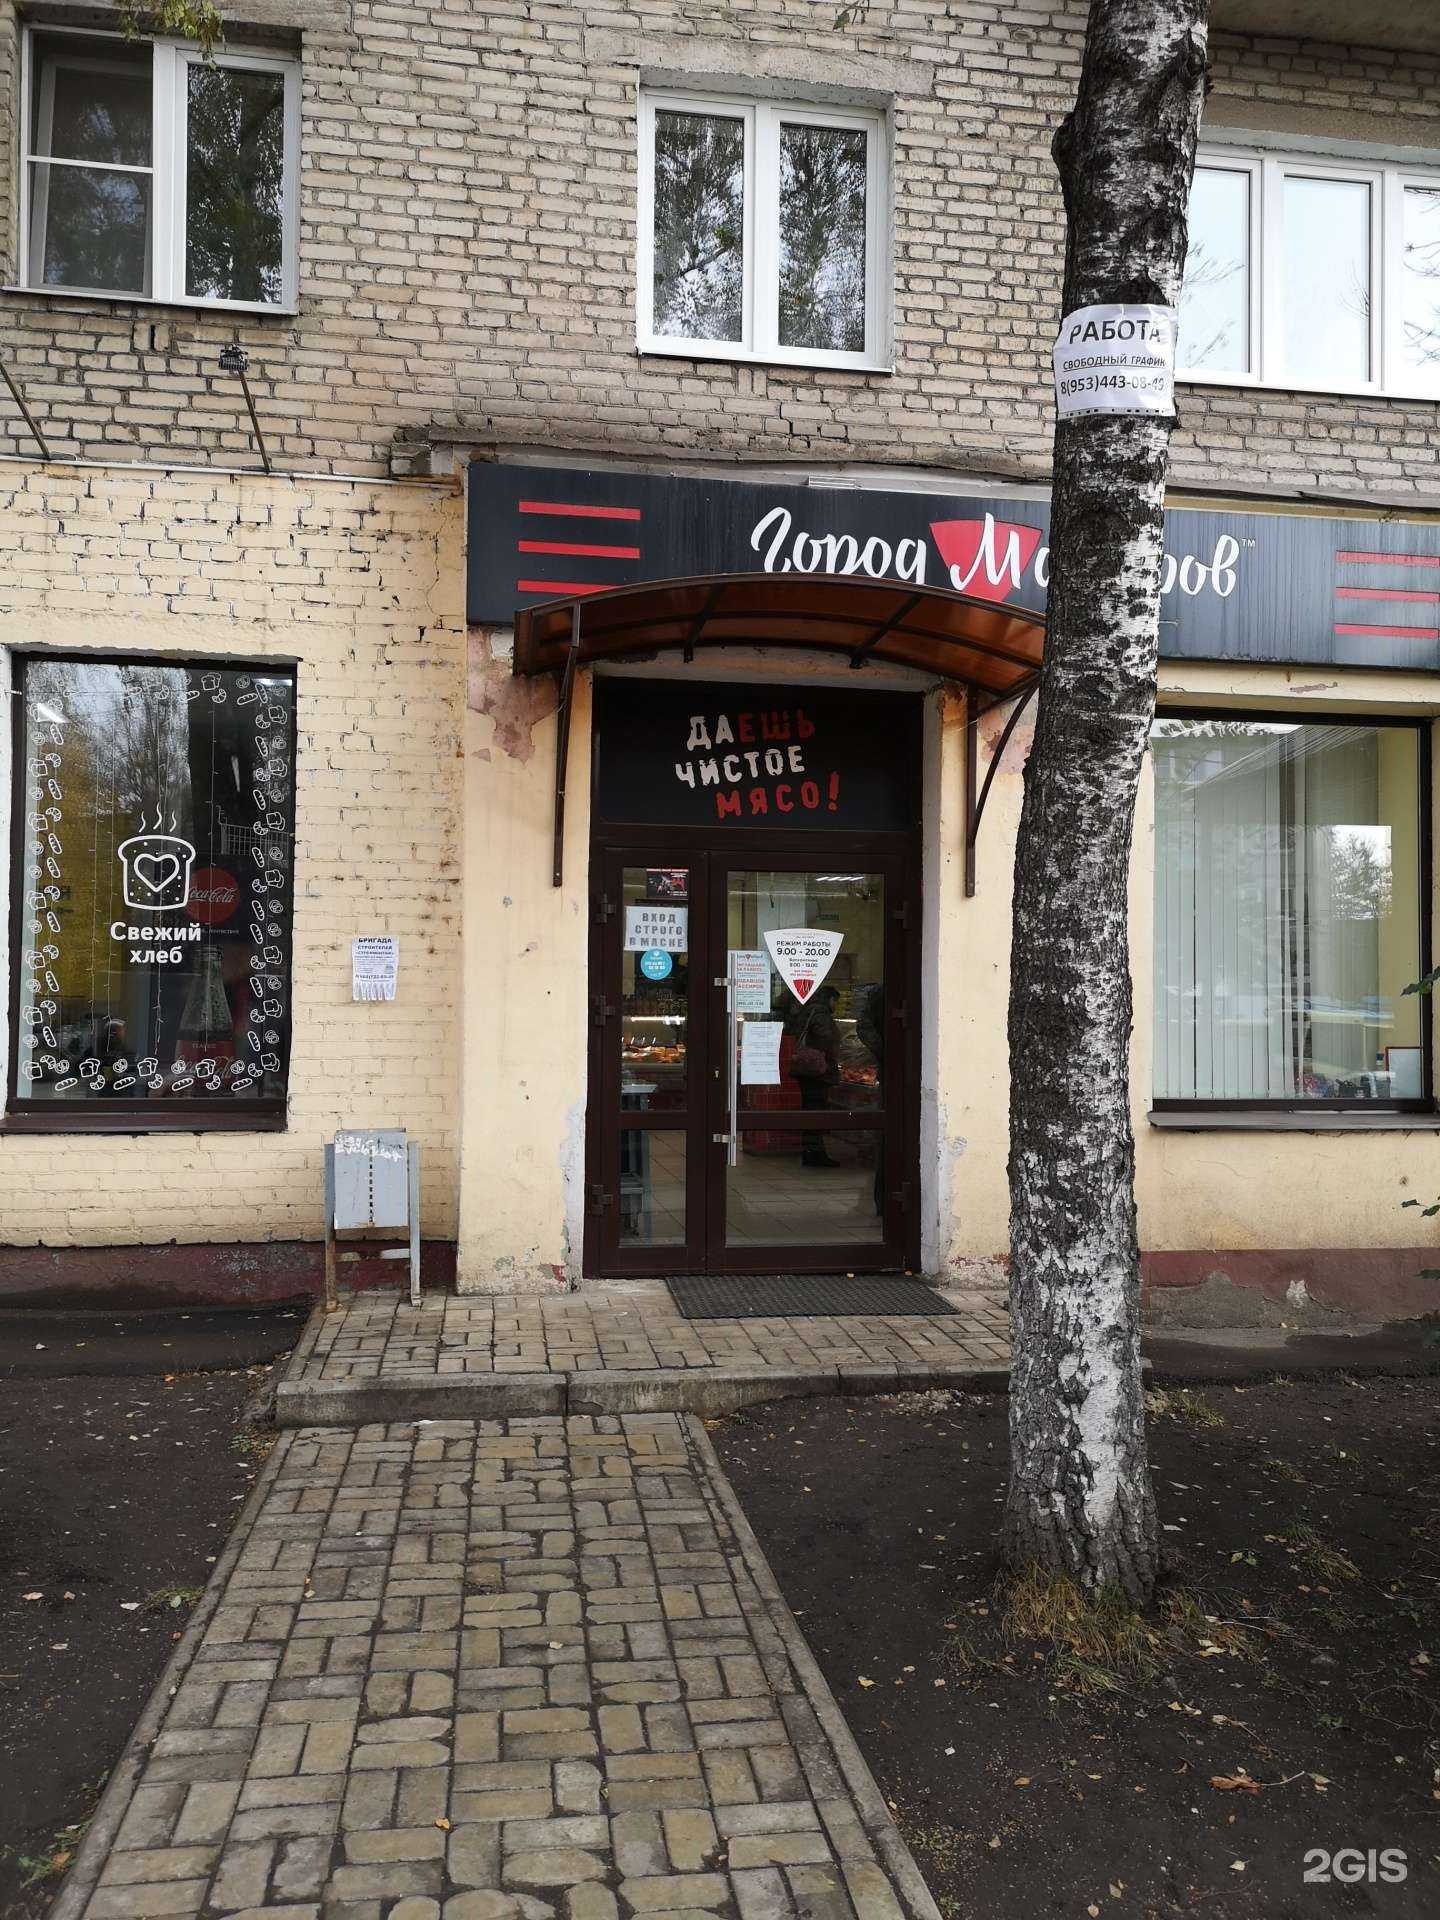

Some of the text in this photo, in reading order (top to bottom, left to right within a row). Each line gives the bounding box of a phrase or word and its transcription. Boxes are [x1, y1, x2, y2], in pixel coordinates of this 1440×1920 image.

[1069, 319, 1161, 345] РАБОТА
[1063, 354, 1166, 370] СВОБОДНЫЙ ГРАФИК
[750, 506, 926, 584] Город
[686, 708, 816, 751] ДАЕШЬ
[675, 745, 805, 789] ЧИСТОЕ
[716, 771, 840, 819] МЯСО!
[642, 912, 677, 924] ВХОД
[110, 921, 202, 941] Свежий
[635, 925, 683, 936] СТРОГО
[629, 936, 684, 948] В МАСКЕ
[129, 946, 183, 964] хлеб
[776, 947, 797, 956] 9.00
[804, 948, 831, 957] 20.00
